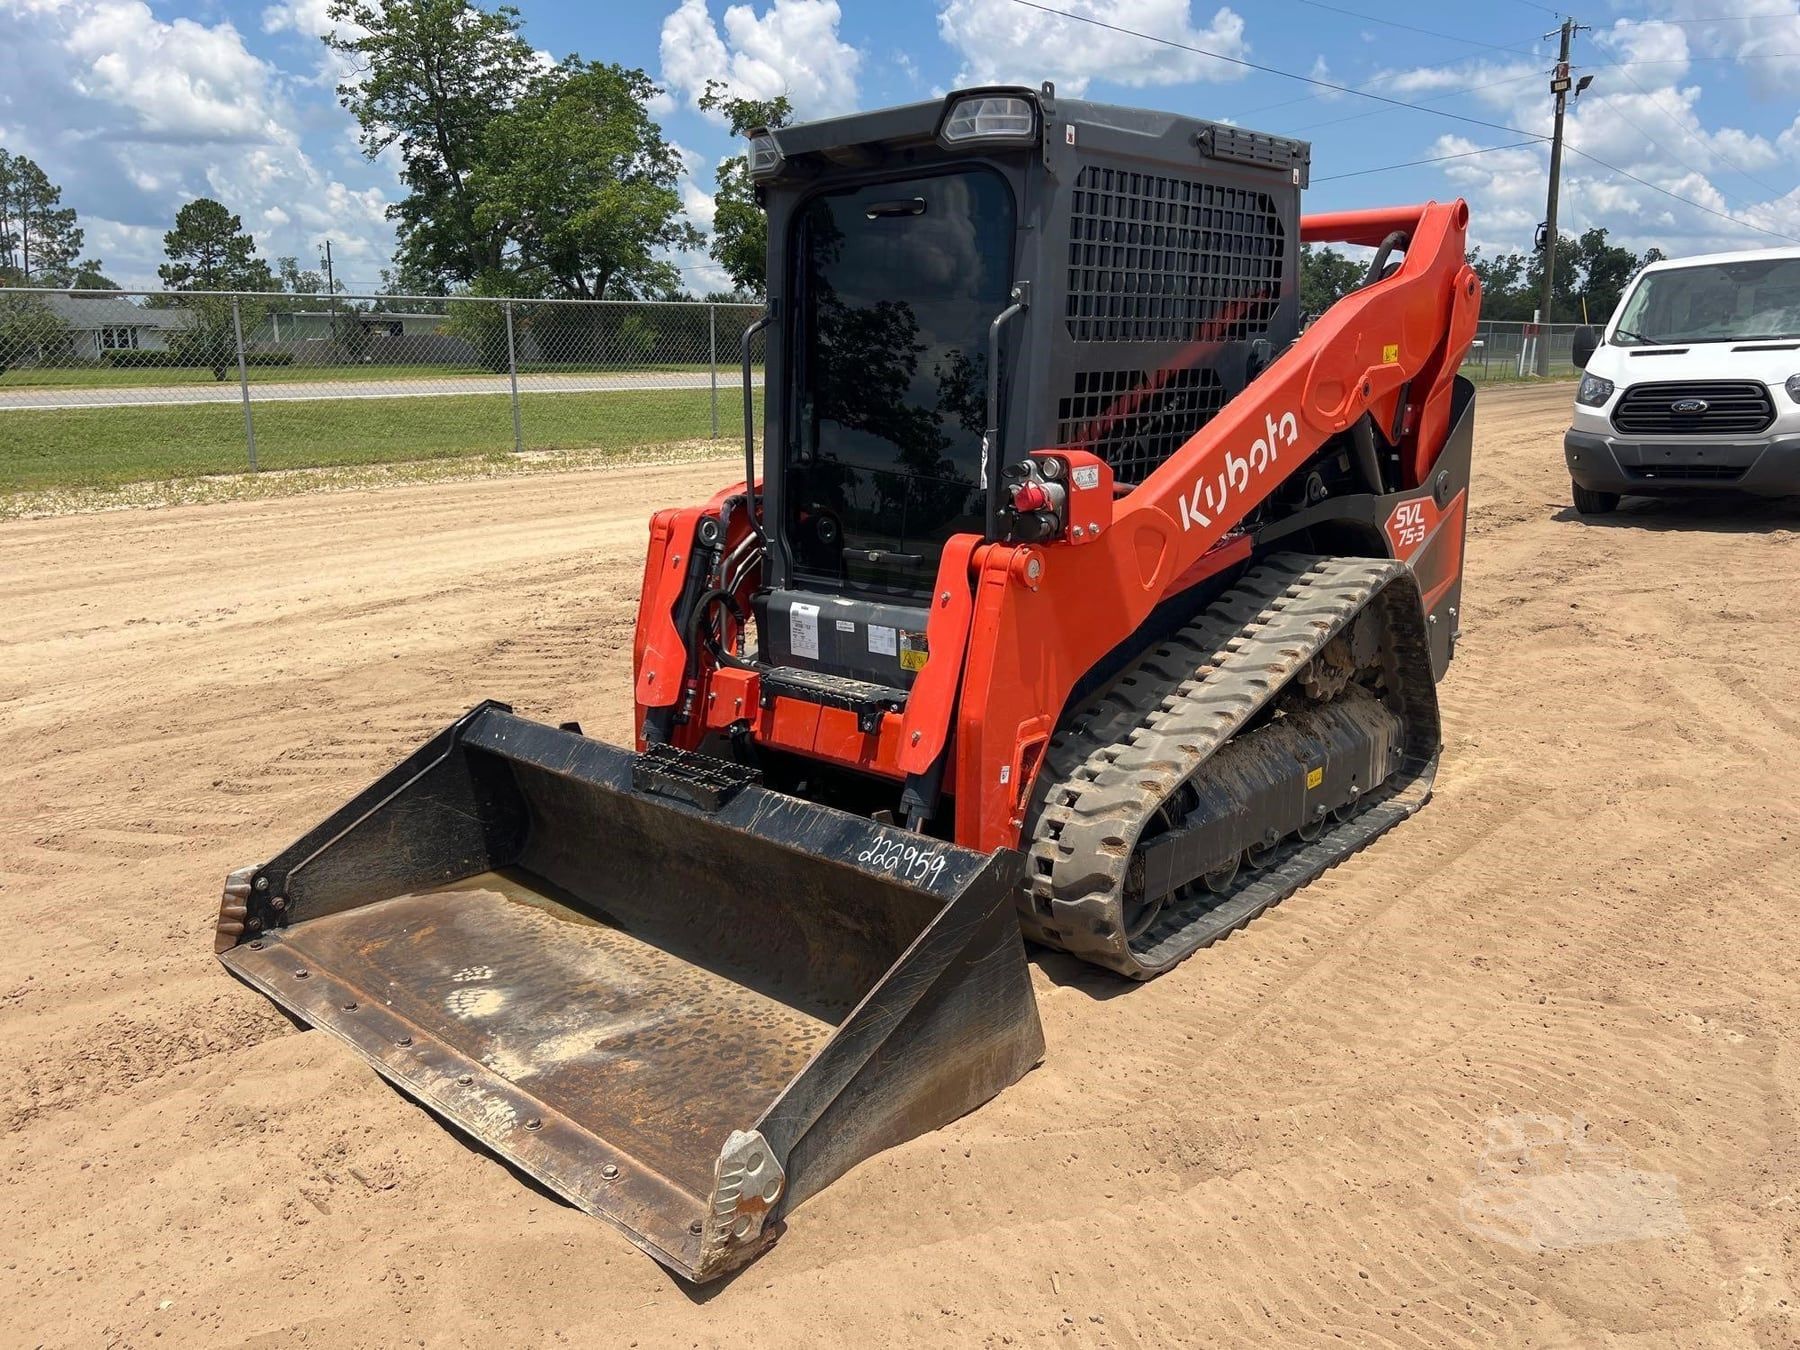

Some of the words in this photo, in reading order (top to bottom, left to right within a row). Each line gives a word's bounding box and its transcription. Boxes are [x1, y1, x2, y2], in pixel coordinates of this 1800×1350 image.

[1678, 401, 1700, 412] Ford
[1178, 411, 1298, 531] Kubota
[1394, 503, 1425, 529] SVL
[1398, 525, 1425, 547] 75-3
[858, 836, 946, 890] 222959
